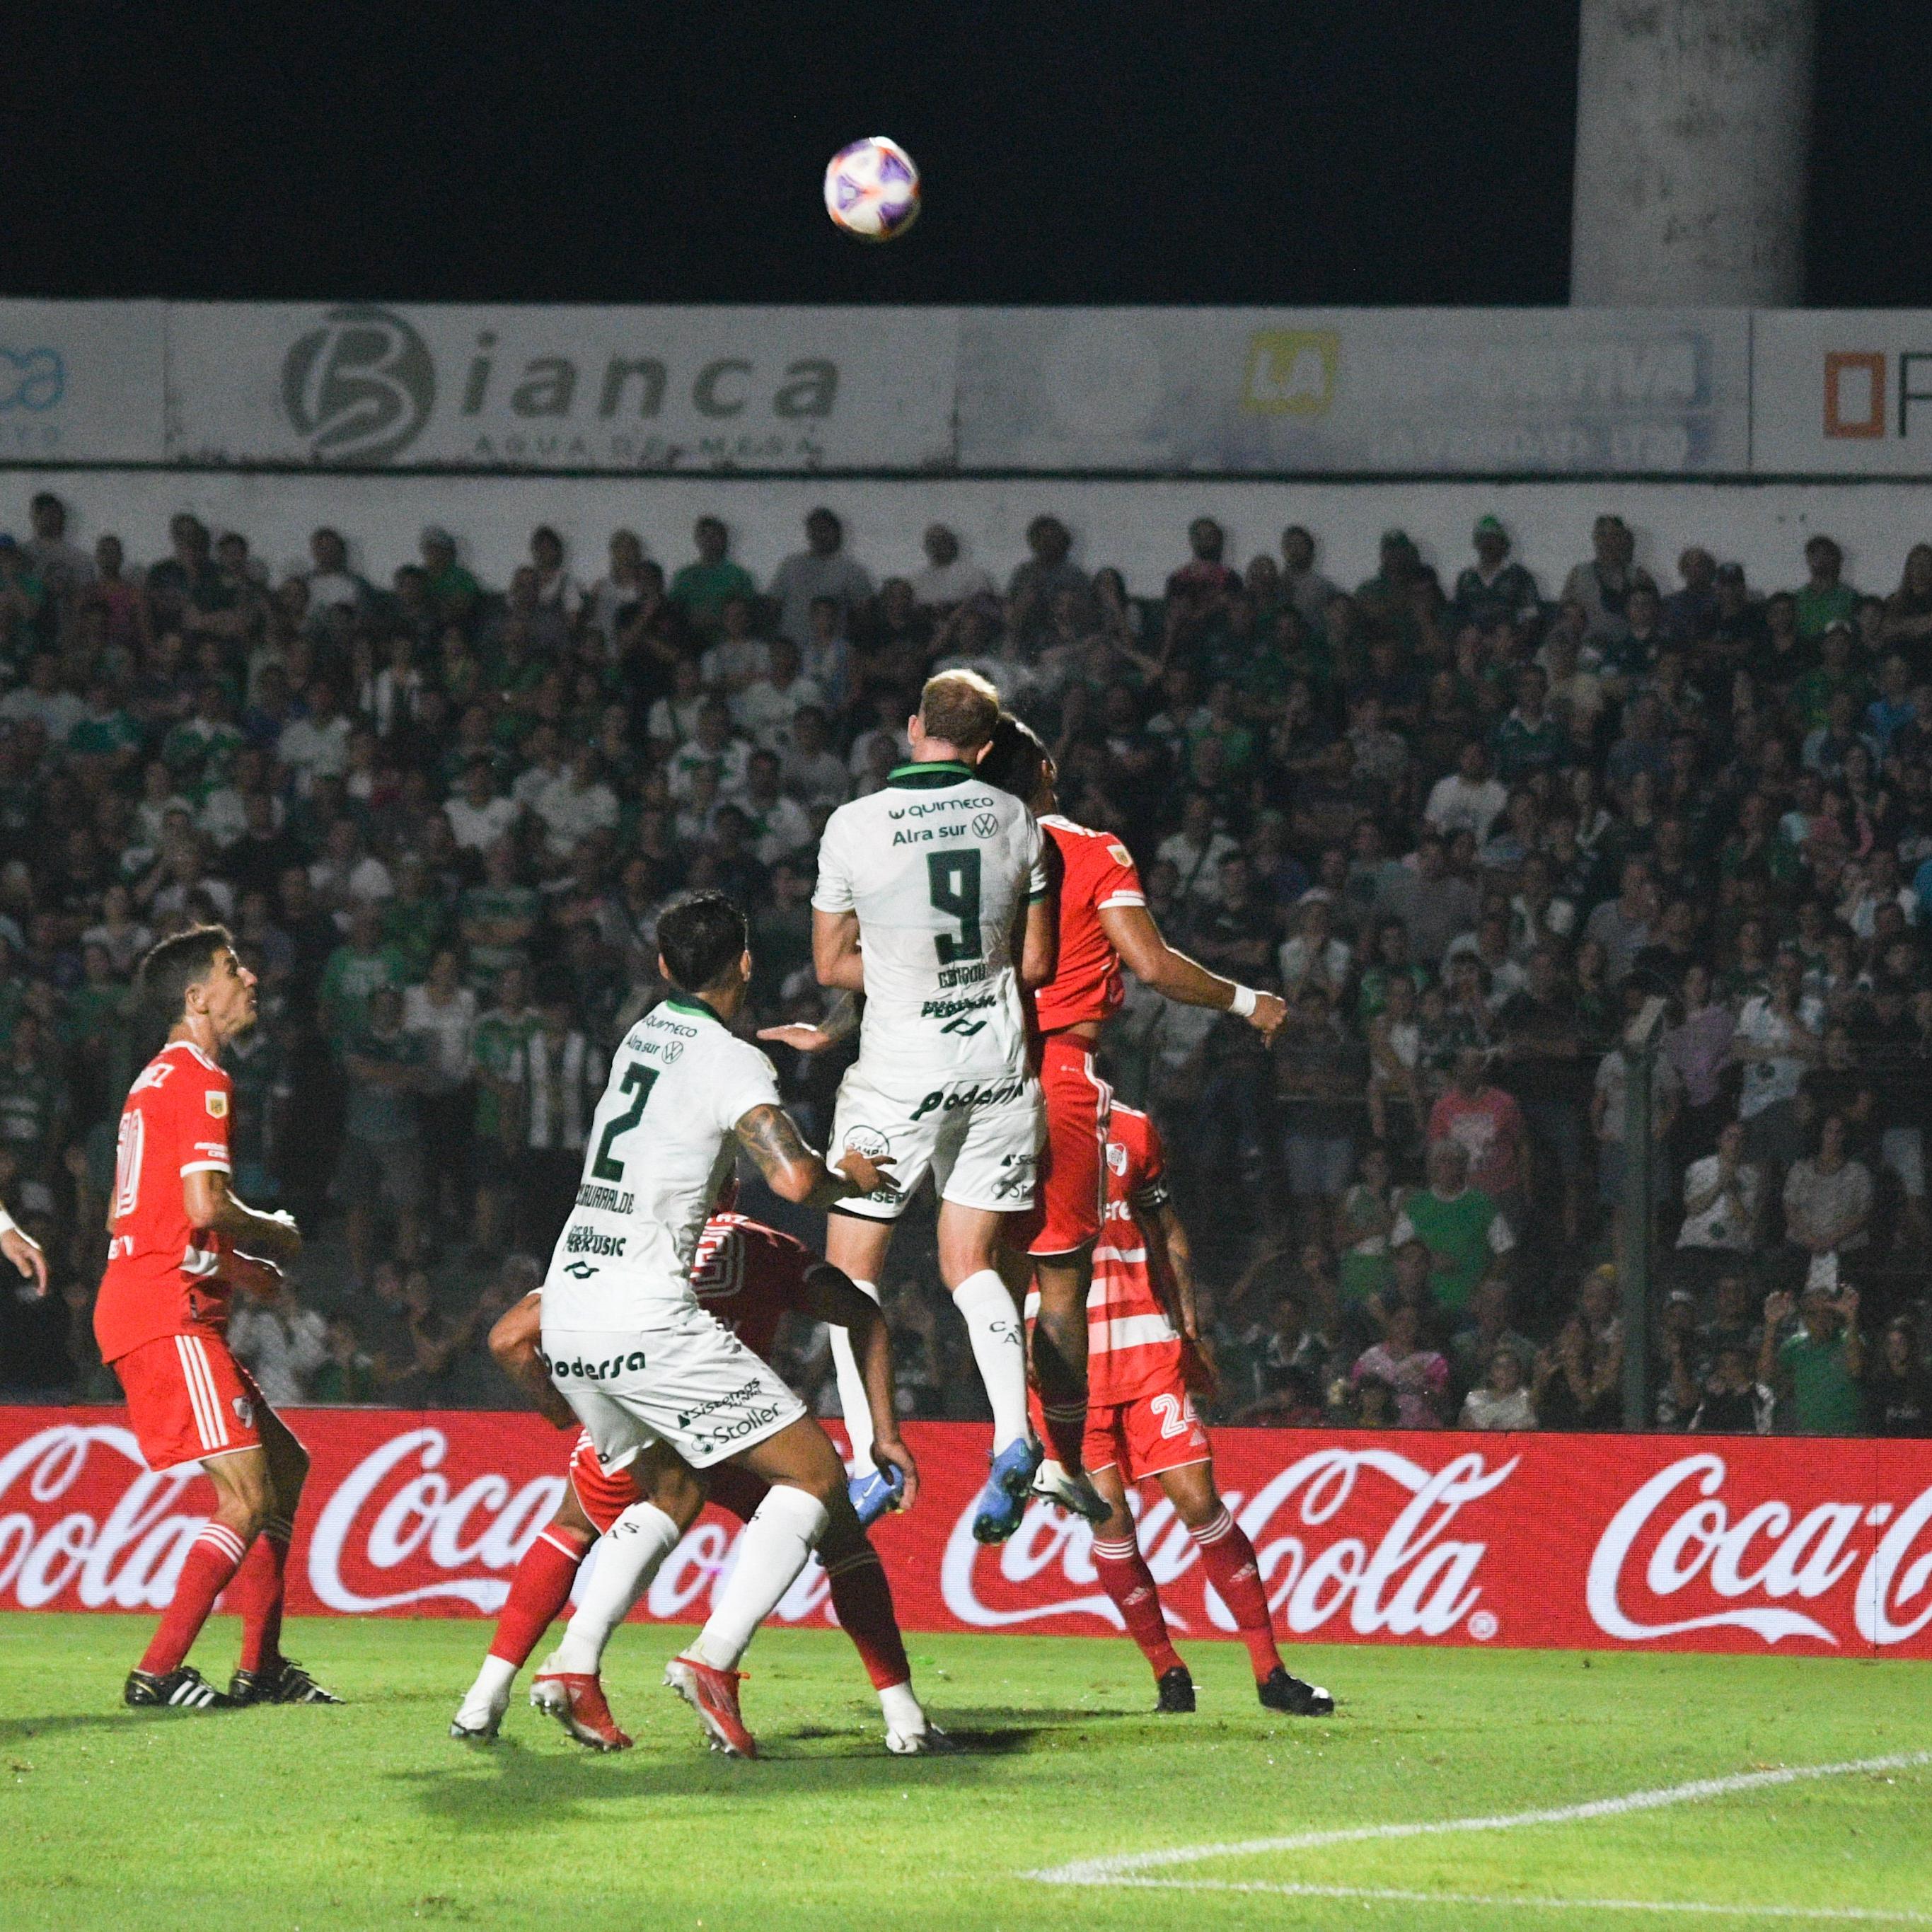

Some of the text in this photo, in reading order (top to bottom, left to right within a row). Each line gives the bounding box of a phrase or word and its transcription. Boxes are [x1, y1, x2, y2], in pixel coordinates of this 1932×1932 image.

[283, 306, 840, 464] Bianca
[892, 828, 933, 847] Alra
[939, 825, 966, 838] sur
[926, 848, 982, 965] 9
[590, 1061, 660, 1183] 2
[713, 1402, 778, 1445] Stoller
